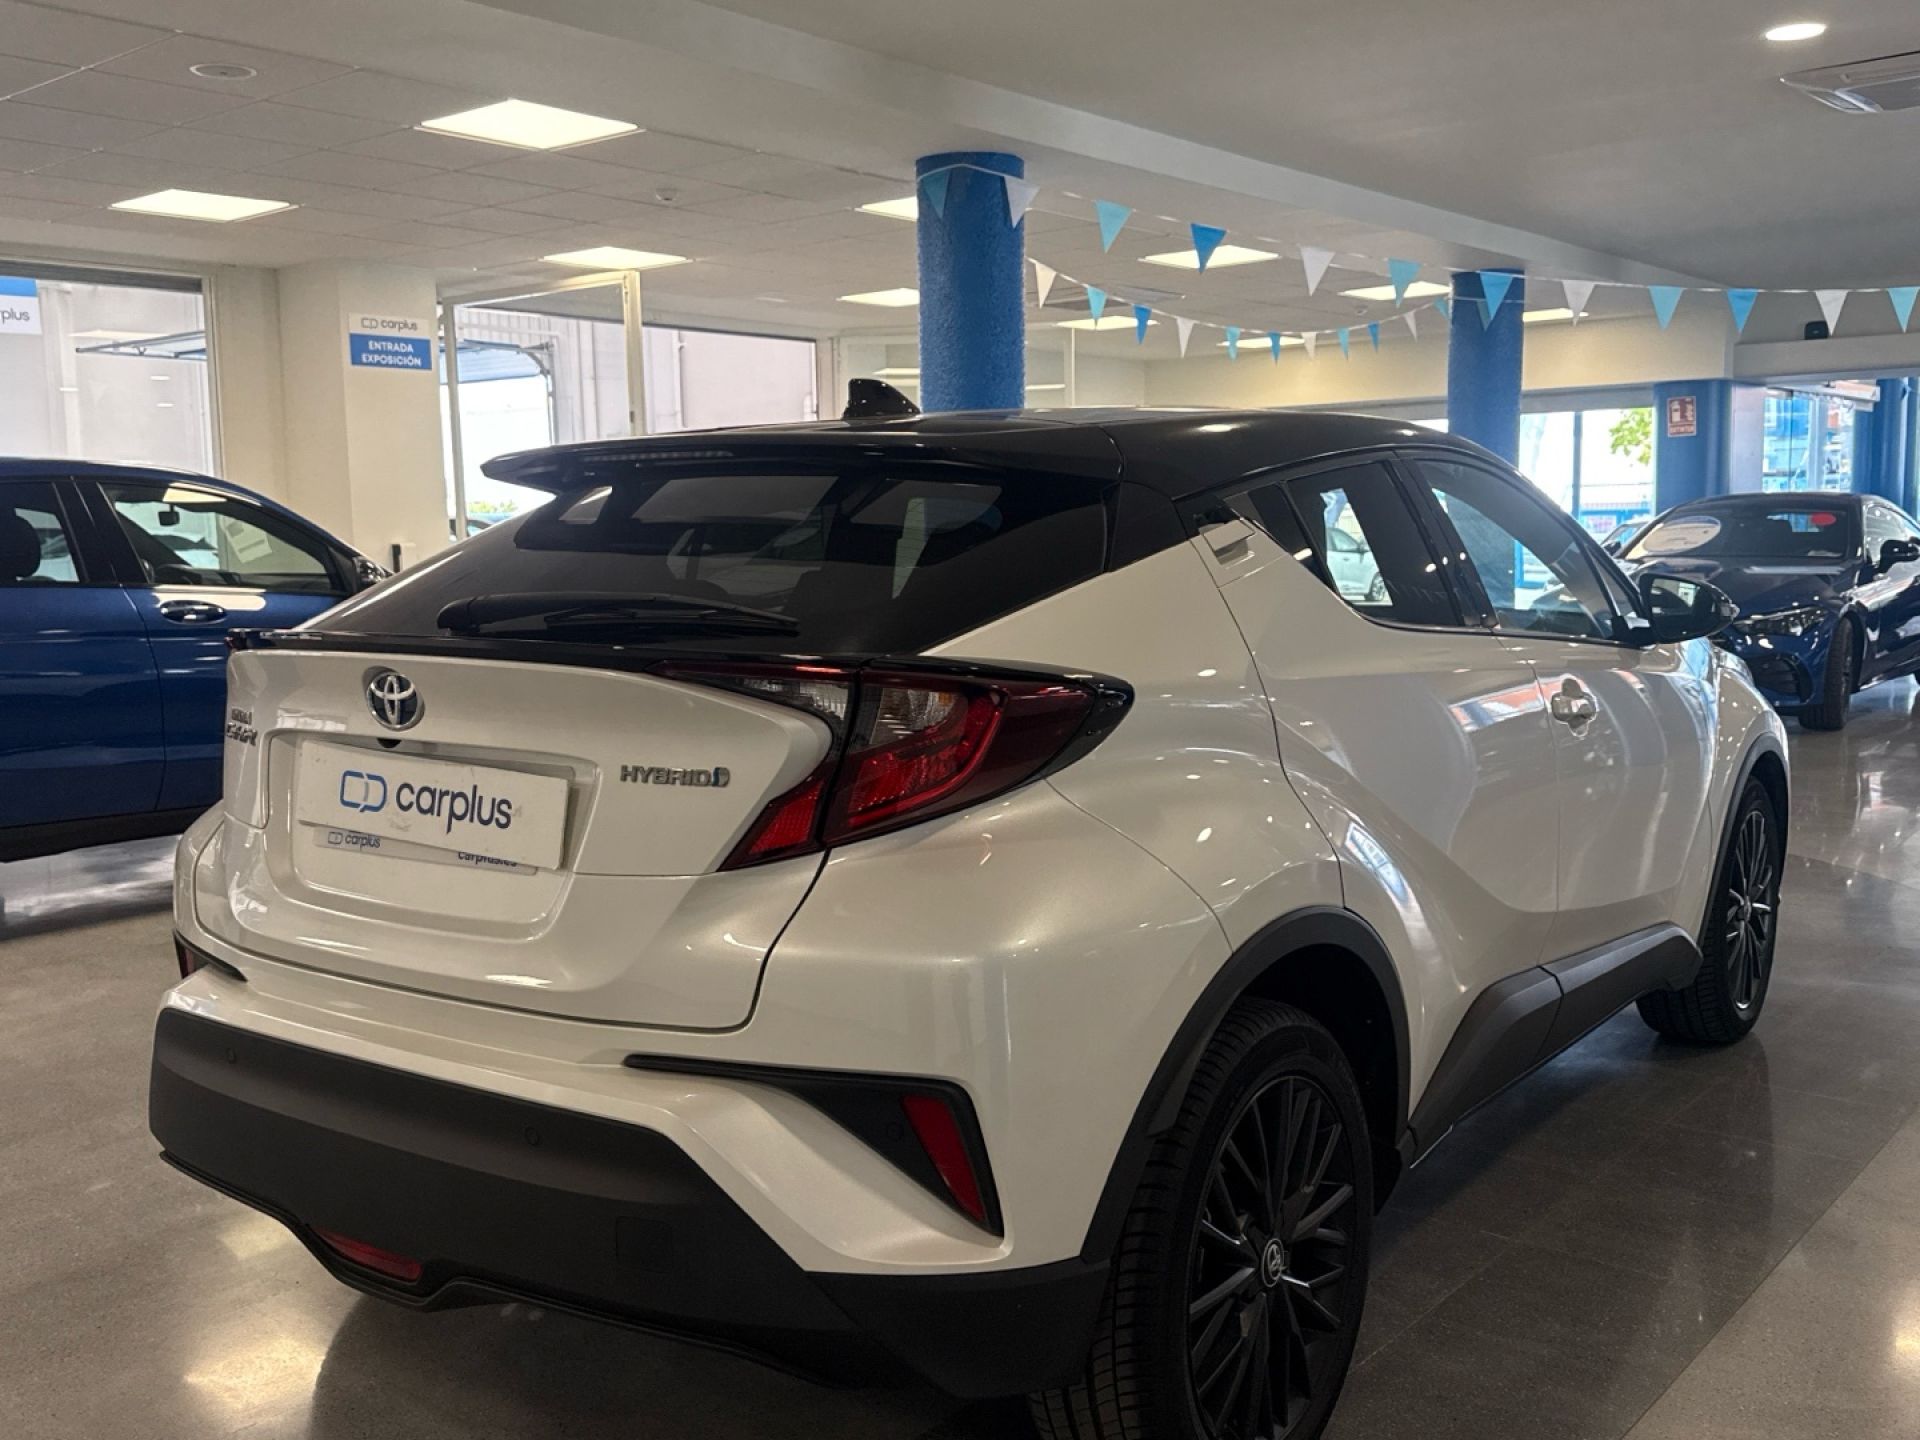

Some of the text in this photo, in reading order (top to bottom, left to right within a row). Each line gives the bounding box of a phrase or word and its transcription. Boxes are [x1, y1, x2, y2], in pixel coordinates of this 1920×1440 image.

[0, 307, 30, 325] plus
[380, 319, 418, 332] carplus
[368, 340, 414, 353] ENTRADA
[361, 353, 422, 366] EXPOSICIÓN
[620, 765, 712, 787] HYBRID
[396, 782, 512, 834] carplus
[345, 834, 381, 852] carplus
